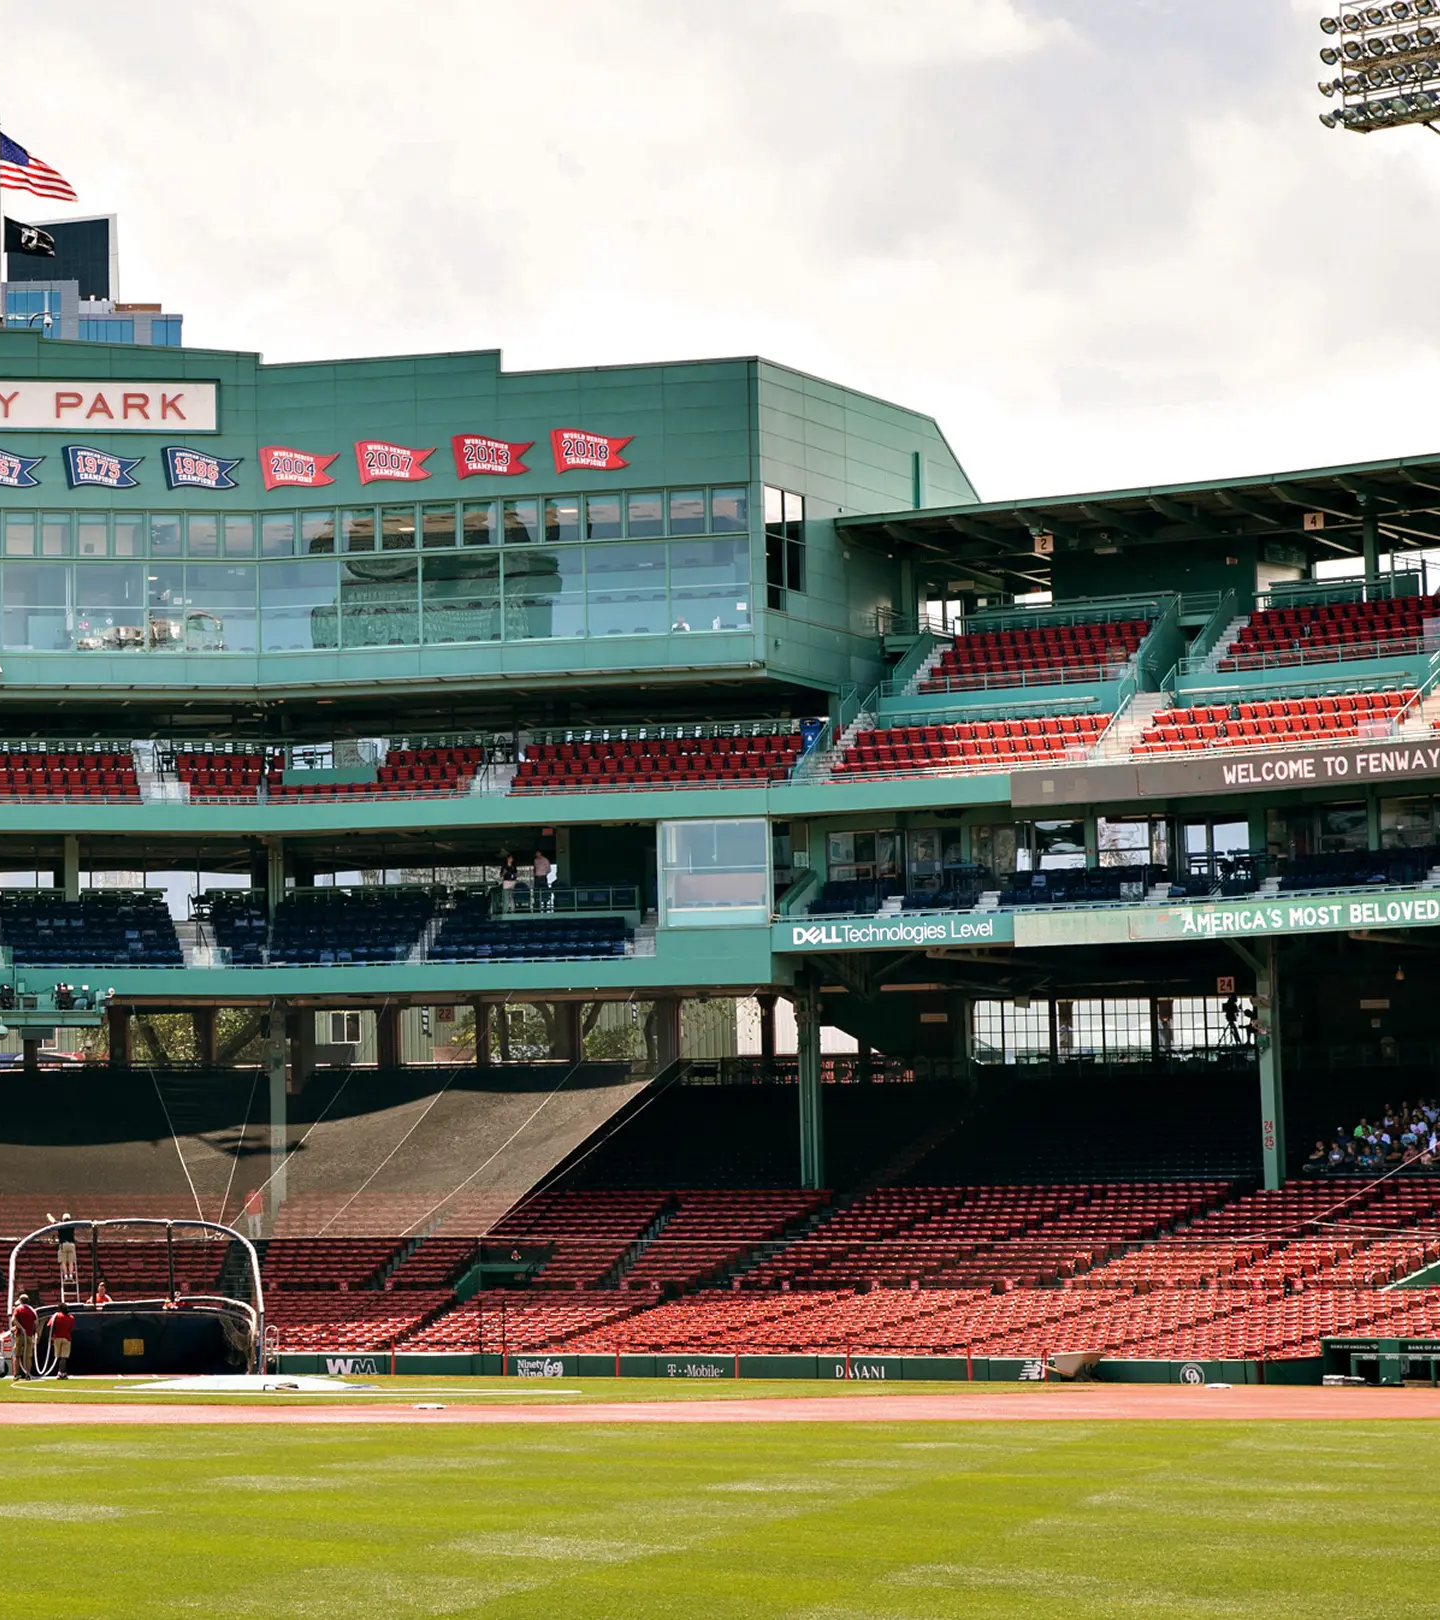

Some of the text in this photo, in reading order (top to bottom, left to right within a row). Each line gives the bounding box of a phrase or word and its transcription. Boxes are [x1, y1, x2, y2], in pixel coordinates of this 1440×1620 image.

[55, 391, 187, 420] PARK
[464, 438, 486, 446] WORLD
[563, 432, 585, 441] WORLD
[367, 444, 389, 452] WORLD
[562, 439, 609, 460] 2018
[273, 450, 293, 458] WORLD
[463, 445, 509, 465] 2013
[365, 451, 413, 471] 2007
[566, 457, 606, 467] CHAMPIONS
[76, 456, 121, 479] 1975
[175, 456, 219, 480] 1986
[271, 457, 316, 477] 2004
[468, 462, 507, 472] CHAMPIONS
[276, 473, 312, 483] CHAMPIONS
[370, 468, 409, 478] CHAMPIONS
[79, 473, 117, 485] CHAMPIONS
[178, 474, 216, 486] CHAMPIONS
[1310, 516, 1317, 527] 4
[1040, 539, 1047, 550] 2
[1223, 748, 1440, 785] WELCOME TO FENWAY
[1182, 900, 1440, 934] AMERICA'S MOST BELOVED
[792, 918, 993, 945] DELL Technologies Level
[1220, 979, 1232, 991] 24
[439, 1009, 451, 1020] 22
[1264, 1121, 1273, 1130] 24
[1264, 1136, 1274, 1147] 25
[326, 1358, 378, 1374] WM
[517, 1359, 544, 1369] Ninety
[518, 1369, 543, 1377] Nine
